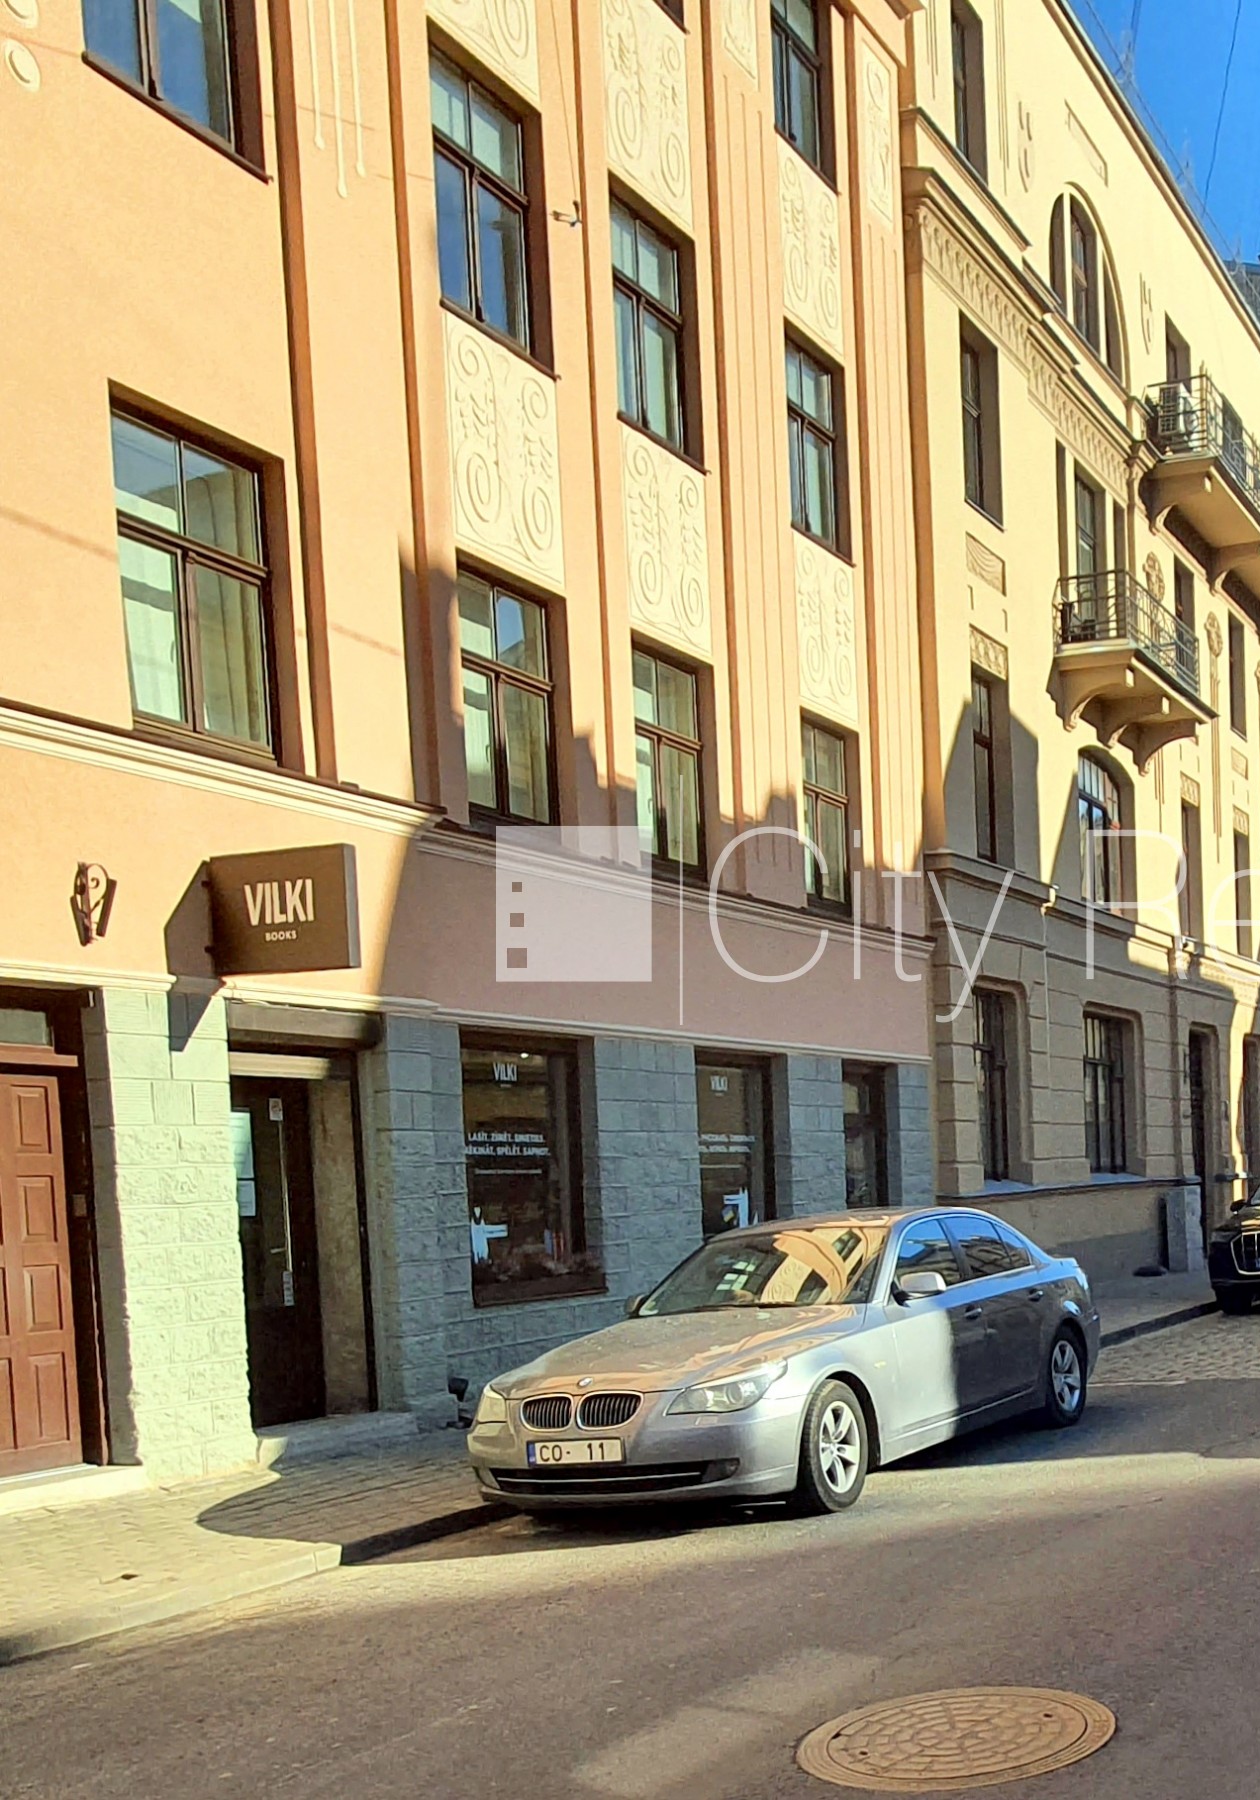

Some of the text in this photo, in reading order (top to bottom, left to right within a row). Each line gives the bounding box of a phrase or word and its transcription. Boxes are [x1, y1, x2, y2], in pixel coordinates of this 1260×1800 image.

[244, 878, 314, 926] VILKI
[265, 929, 297, 942] BOOKS
[493, 1062, 517, 1082] VILKI
